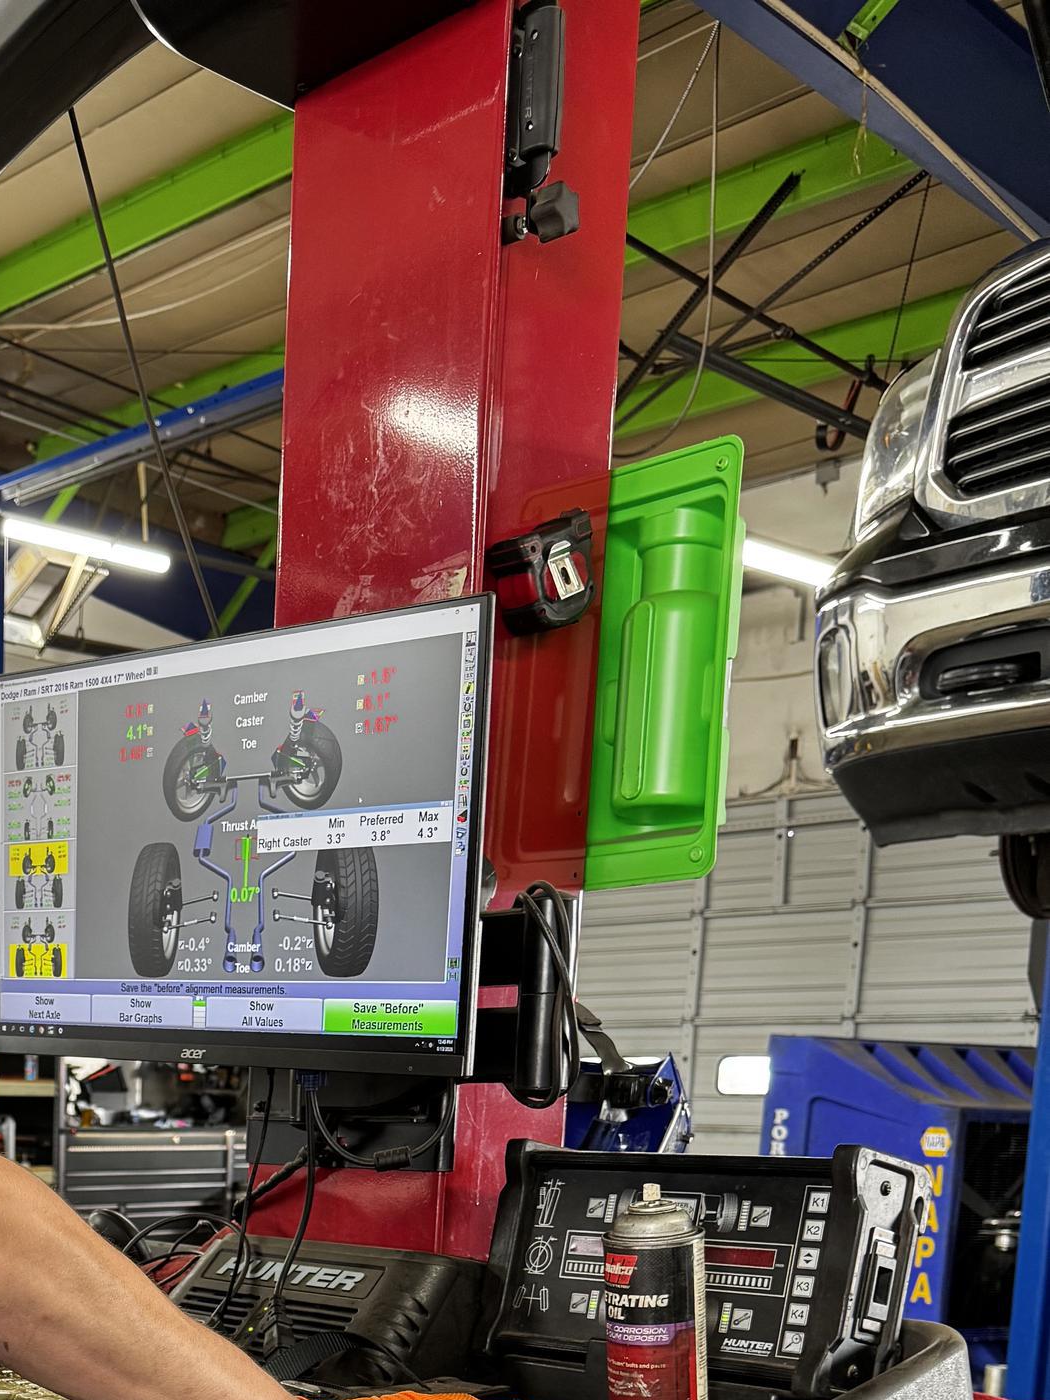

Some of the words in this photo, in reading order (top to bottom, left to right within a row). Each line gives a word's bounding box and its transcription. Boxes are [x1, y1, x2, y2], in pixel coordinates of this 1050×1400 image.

[1, 691, 20, 701] Dodge
[23, 687, 37, 696] Ram
[41, 683, 54, 694] SRT
[54, 682, 69, 692] 2016
[70, 680, 84, 690] Ram
[85, 678, 100, 688] 1500
[100, 675, 112, 685] 4X4
[125, 671, 145, 681] Wheel
[234, 691, 268, 706] Camber
[235, 715, 264, 728] Caster
[126, 724, 147, 741] 4.1°
[241, 738, 257, 750] Toe
[328, 818, 345, 829] Min
[359, 813, 404, 827] Preferred
[418, 811, 439, 823] Max
[221, 821, 249, 832] Thrust
[258, 837, 281, 851] Right
[283, 835, 312, 848] Caster
[326, 833, 346, 844] 3.3°
[371, 830, 391, 842] 3.8°
[417, 827, 438, 839] 4.3°
[230, 887, 260, 903] 0.07°
[185, 937, 210, 951] -0.4°
[227, 941, 261, 953] Camber
[279, 936, 306, 951] -0.2°
[184, 958, 212, 972] 0.33°
[235, 963, 250, 974] Toe
[275, 958, 306, 972] 0.18°
[120, 983, 138, 993] Save
[138, 983, 152, 993] the
[154, 983, 183, 994] "before"
[185, 984, 223, 996] alignment
[224, 984, 287, 995] measurements.
[35, 996, 54, 1006] Show
[130, 999, 152, 1008] Show
[249, 1001, 274, 1011] Show
[28, 1010, 44, 1020] Next
[44, 1010, 61, 1020] Axle
[353, 1003, 377, 1014] Save
[380, 1003, 424, 1015] "Before"
[119, 1013, 133, 1022] Bar
[134, 1013, 162, 1024] Graphs
[241, 1017, 254, 1027] All
[255, 1017, 284, 1027] Values
[352, 1019, 423, 1032] Measurements
[180, 1048, 206, 1059] acer
[811, 1197, 825, 1208] K1
[806, 1225, 820, 1236] K2
[216, 1256, 365, 1291] HUNTER
[795, 1281, 810, 1292] K3
[607, 1306, 625, 1321] OIL
[790, 1309, 804, 1320] K4
[622, 1333, 669, 1342] DEPOSITS
[722, 1337, 774, 1351] HUNTER
